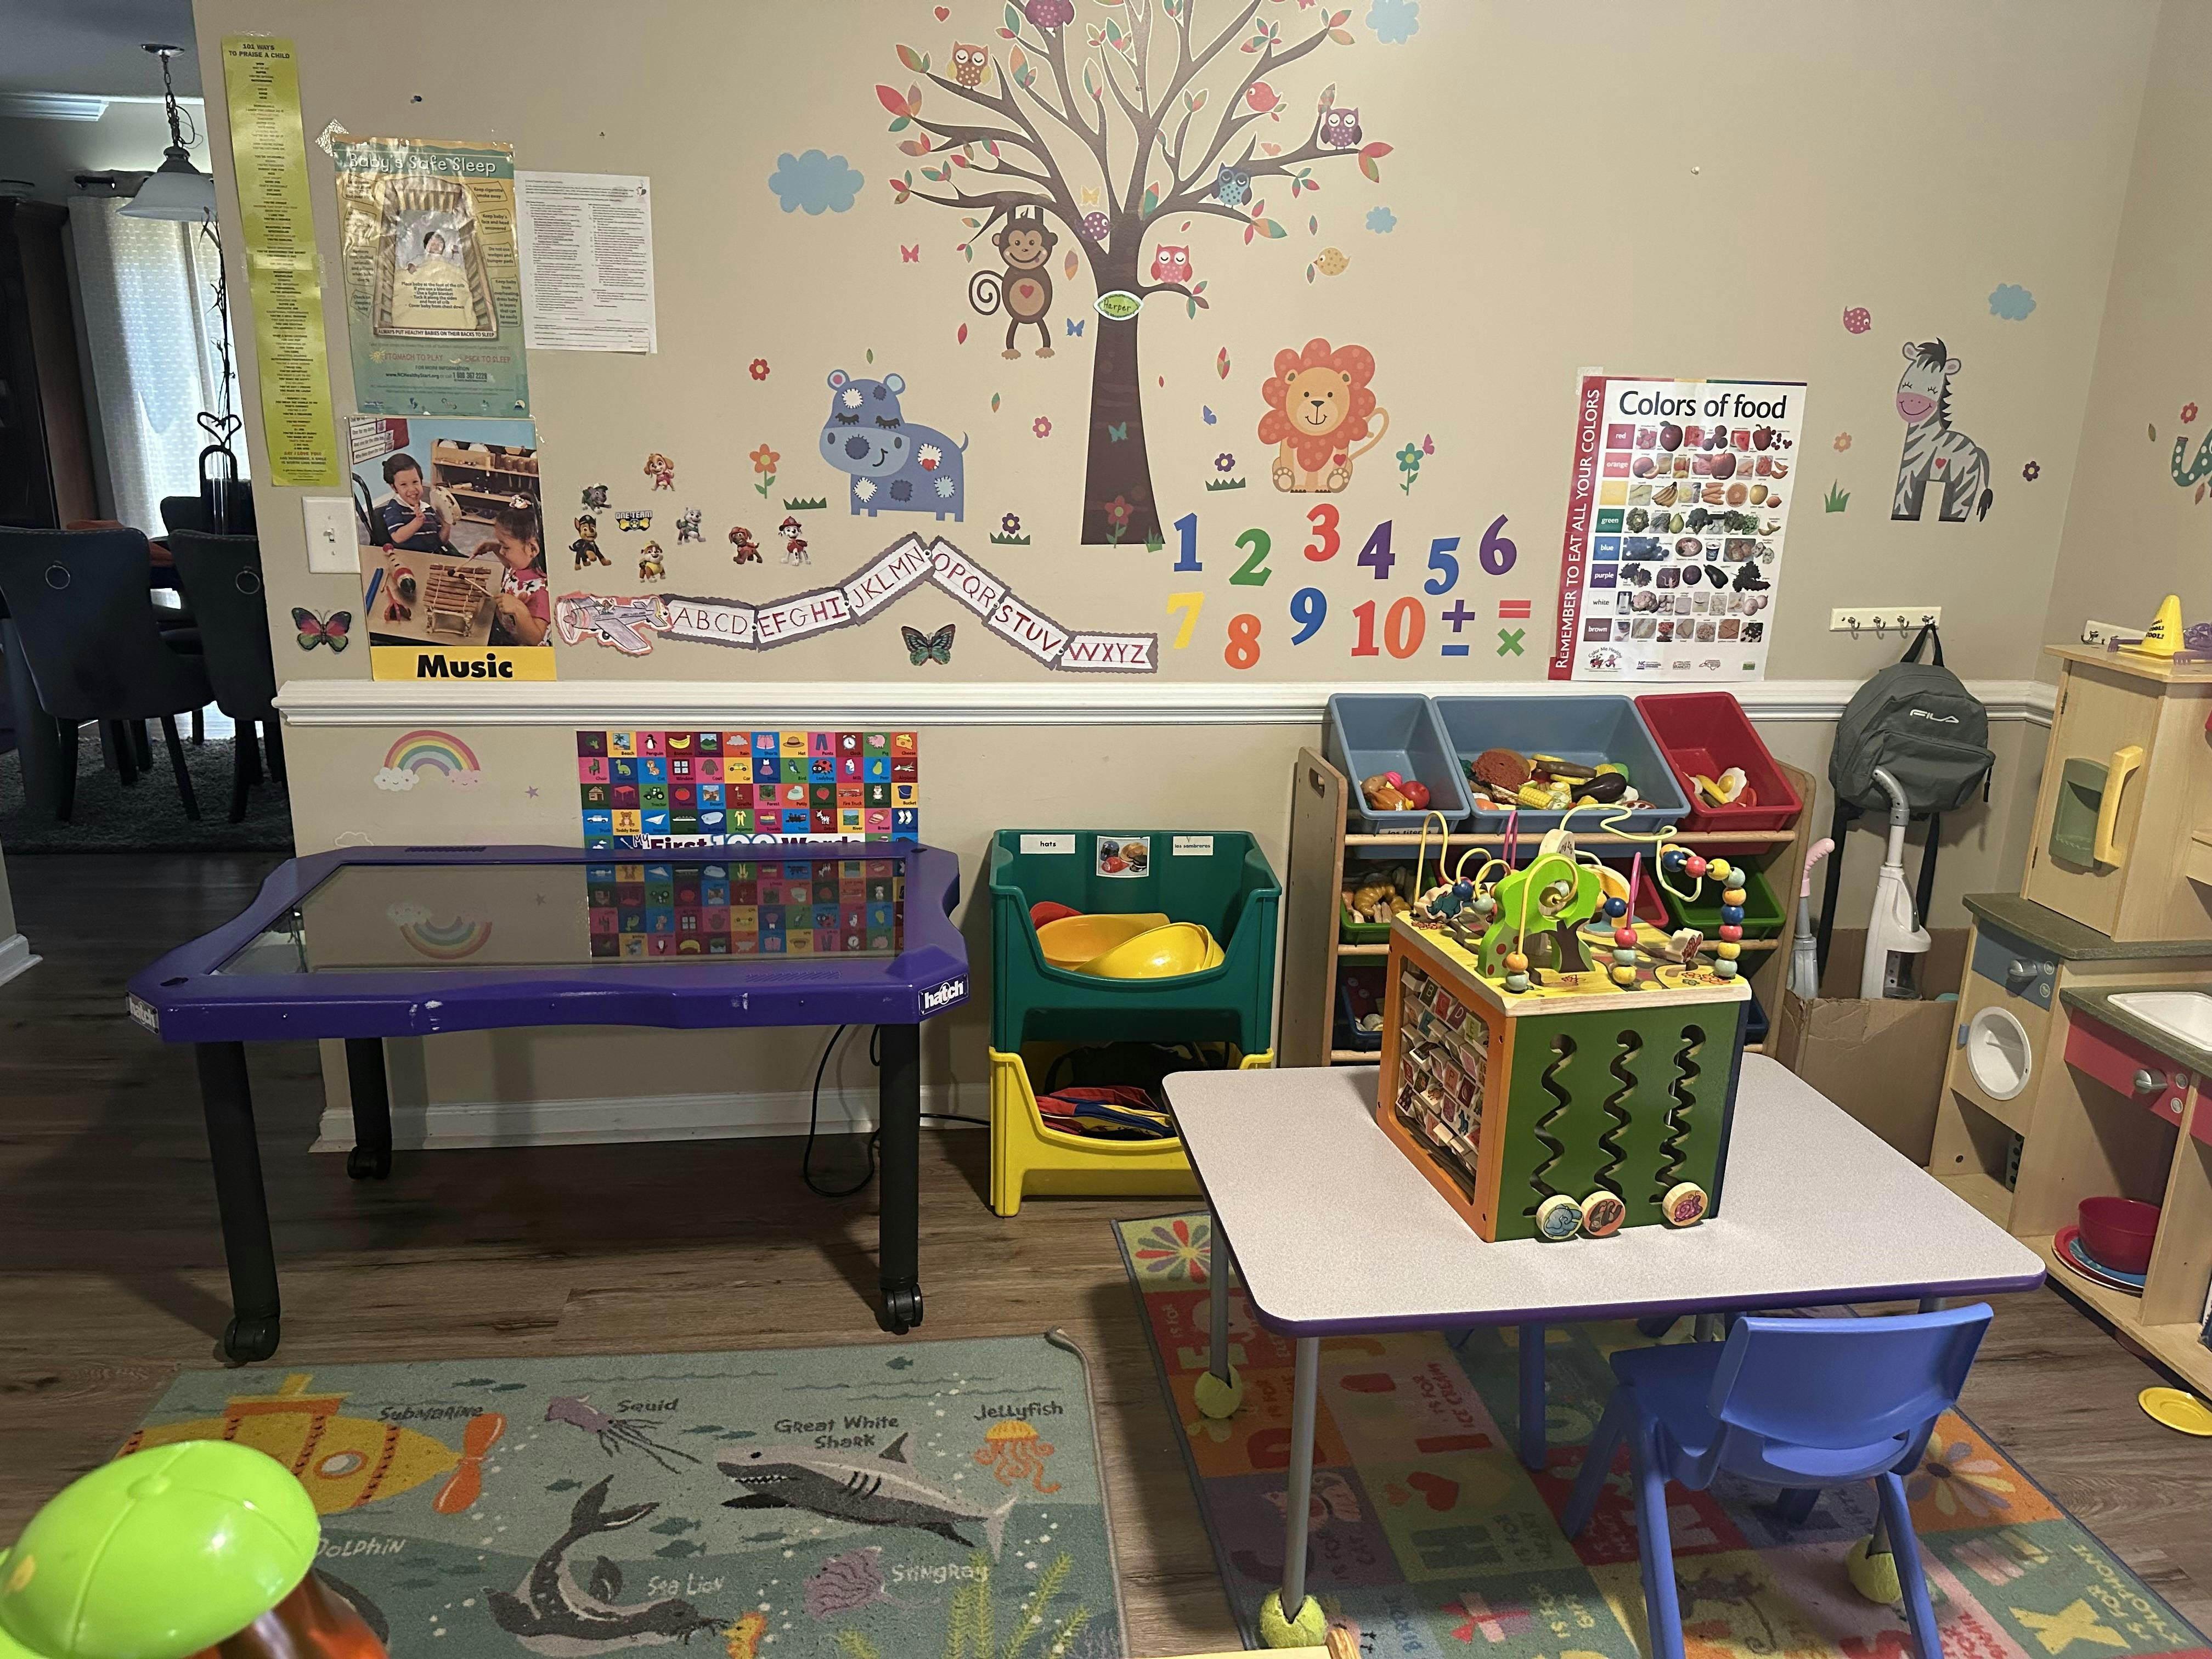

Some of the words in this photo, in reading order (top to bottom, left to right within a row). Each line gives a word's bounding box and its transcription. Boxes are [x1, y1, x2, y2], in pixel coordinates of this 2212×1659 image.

[349, 153, 403, 172] Baby's
[409, 155, 447, 171] Safe
[452, 157, 497, 177] Sleep
[1103, 299, 1132, 313] Harper
[1619, 390, 1696, 417] Colors
[1704, 394, 1730, 417] of
[1733, 395, 1787, 419] food
[1581, 388, 1600, 458] COLORS
[1606, 461, 1629, 470] orange
[1576, 461, 1593, 500] YOUR
[631, 510, 653, 519] TEAM
[1577, 503, 1587, 532] ALL
[1601, 517, 1620, 525] green
[1173, 512, 1203, 572] 1
[1228, 528, 1272, 586] 2
[1304, 503, 1341, 562] 3
[1357, 520, 1396, 580] 4
[1424, 537, 1461, 595] 5
[1479, 514, 1517, 575] 6
[1568, 531, 1582, 562] EAT
[1600, 544, 1614, 552] blue
[1566, 565, 1580, 588] TO
[1594, 572, 1615, 580] purple
[1166, 591, 1205, 650] 7
[1224, 613, 1262, 669] 8
[1290, 587, 1328, 646] 9
[1351, 596, 1426, 659] 10
[1555, 590, 1577, 669] REMEMBER
[417, 653, 513, 678] Music
[1910, 708, 1960, 724] FILA
[651, 837, 707, 849] First
[1040, 839, 1057, 848] hats
[924, 981, 964, 1009] hatch
[1426, 984, 1435, 997] B
[1454, 1006, 1464, 1019] D
[129, 996, 156, 1030] hatch
[616, 1398, 680, 1413] Squid
[974, 1401, 1065, 1422] Jellyfish
[844, 1414, 900, 1430] White
[647, 1577, 678, 1596] Sea
[686, 1572, 724, 1593] Lion
[2085, 1584, 2129, 1618] FOR
[2008, 1598, 2131, 1656] X
